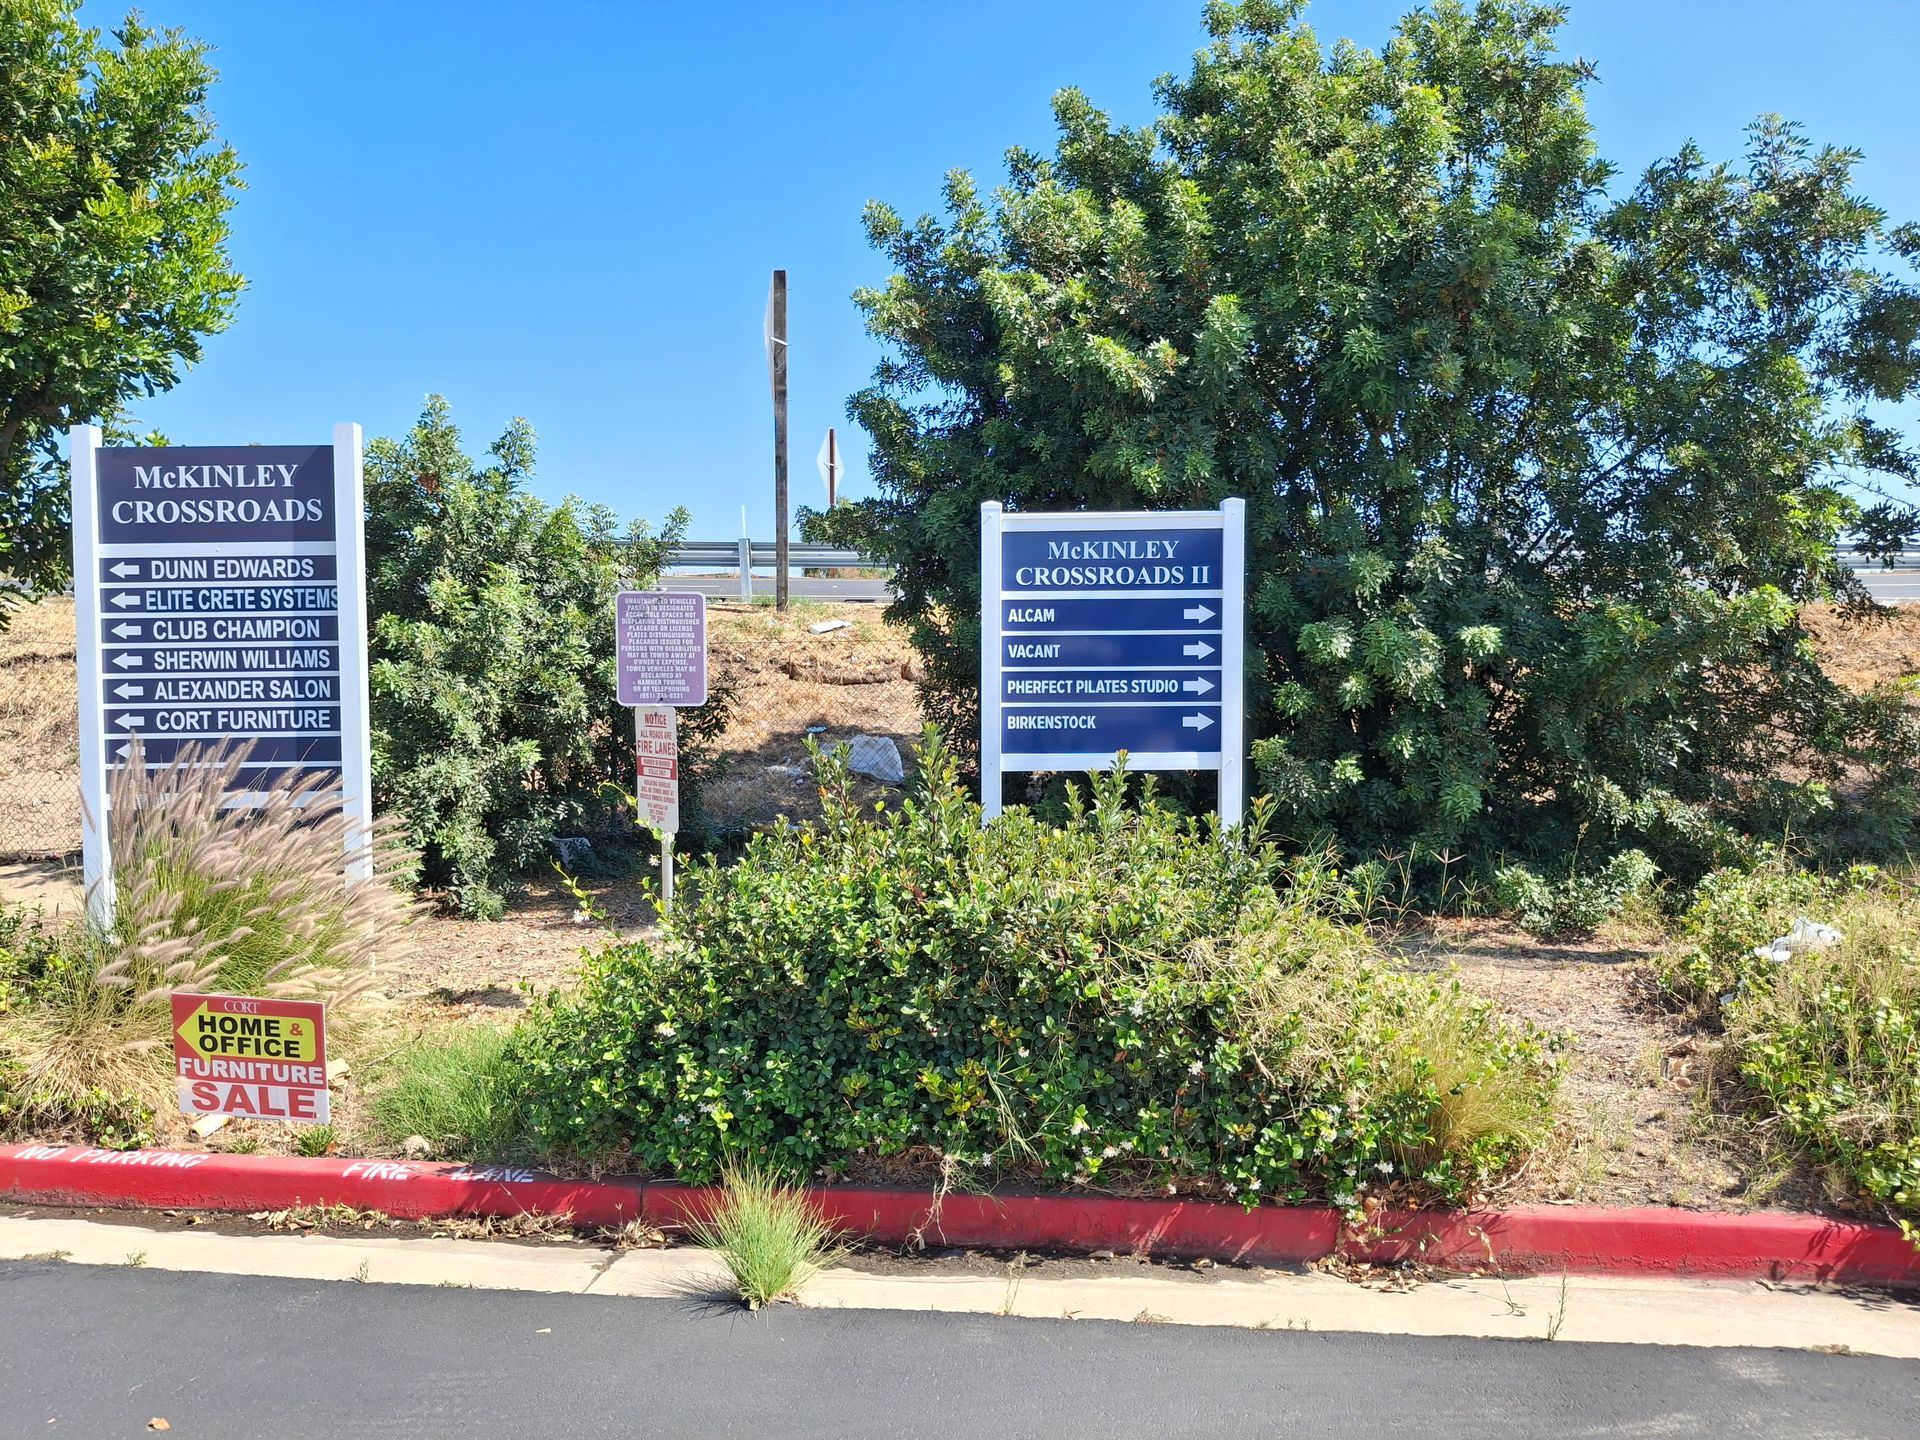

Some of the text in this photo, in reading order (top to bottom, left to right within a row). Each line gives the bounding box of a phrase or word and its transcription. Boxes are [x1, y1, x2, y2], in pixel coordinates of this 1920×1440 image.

[133, 464, 299, 489] McKINLEY
[112, 498, 323, 524] CROSSROADS
[1047, 540, 1180, 560] McKINLEY
[151, 558, 314, 580] DUNN EDWARDS
[1015, 566, 1210, 586] CROSSROADS II
[146, 587, 338, 611] ELITE CRETE SYSTEMS
[1008, 608, 1055, 622] ALCAM
[153, 618, 320, 640] CLUB CHAMPION
[154, 649, 330, 670] SHERWIN WILLIAMS
[1008, 644, 1061, 658] VACANT
[154, 679, 331, 700] ALEXANDER SALON
[1007, 680, 1178, 694] PHERFECT PILATES STUDIO
[155, 709, 331, 731] CORT FURNITURE
[644, 713, 667, 725] NOTICE
[1007, 715, 1096, 729] BIRKENSTOCK
[649, 730, 663, 739] ROADS
[638, 740, 676, 756] FIRE LANES
[224, 999, 258, 1014] CORT
[198, 1015, 304, 1037] HOME &
[199, 1034, 300, 1058] OFFICE
[179, 1057, 324, 1085] FURNITURE
[192, 1082, 317, 1119] SALE
[14, 1145, 210, 1168] NO PARKING
[342, 1162, 539, 1183] FIRE LANE
